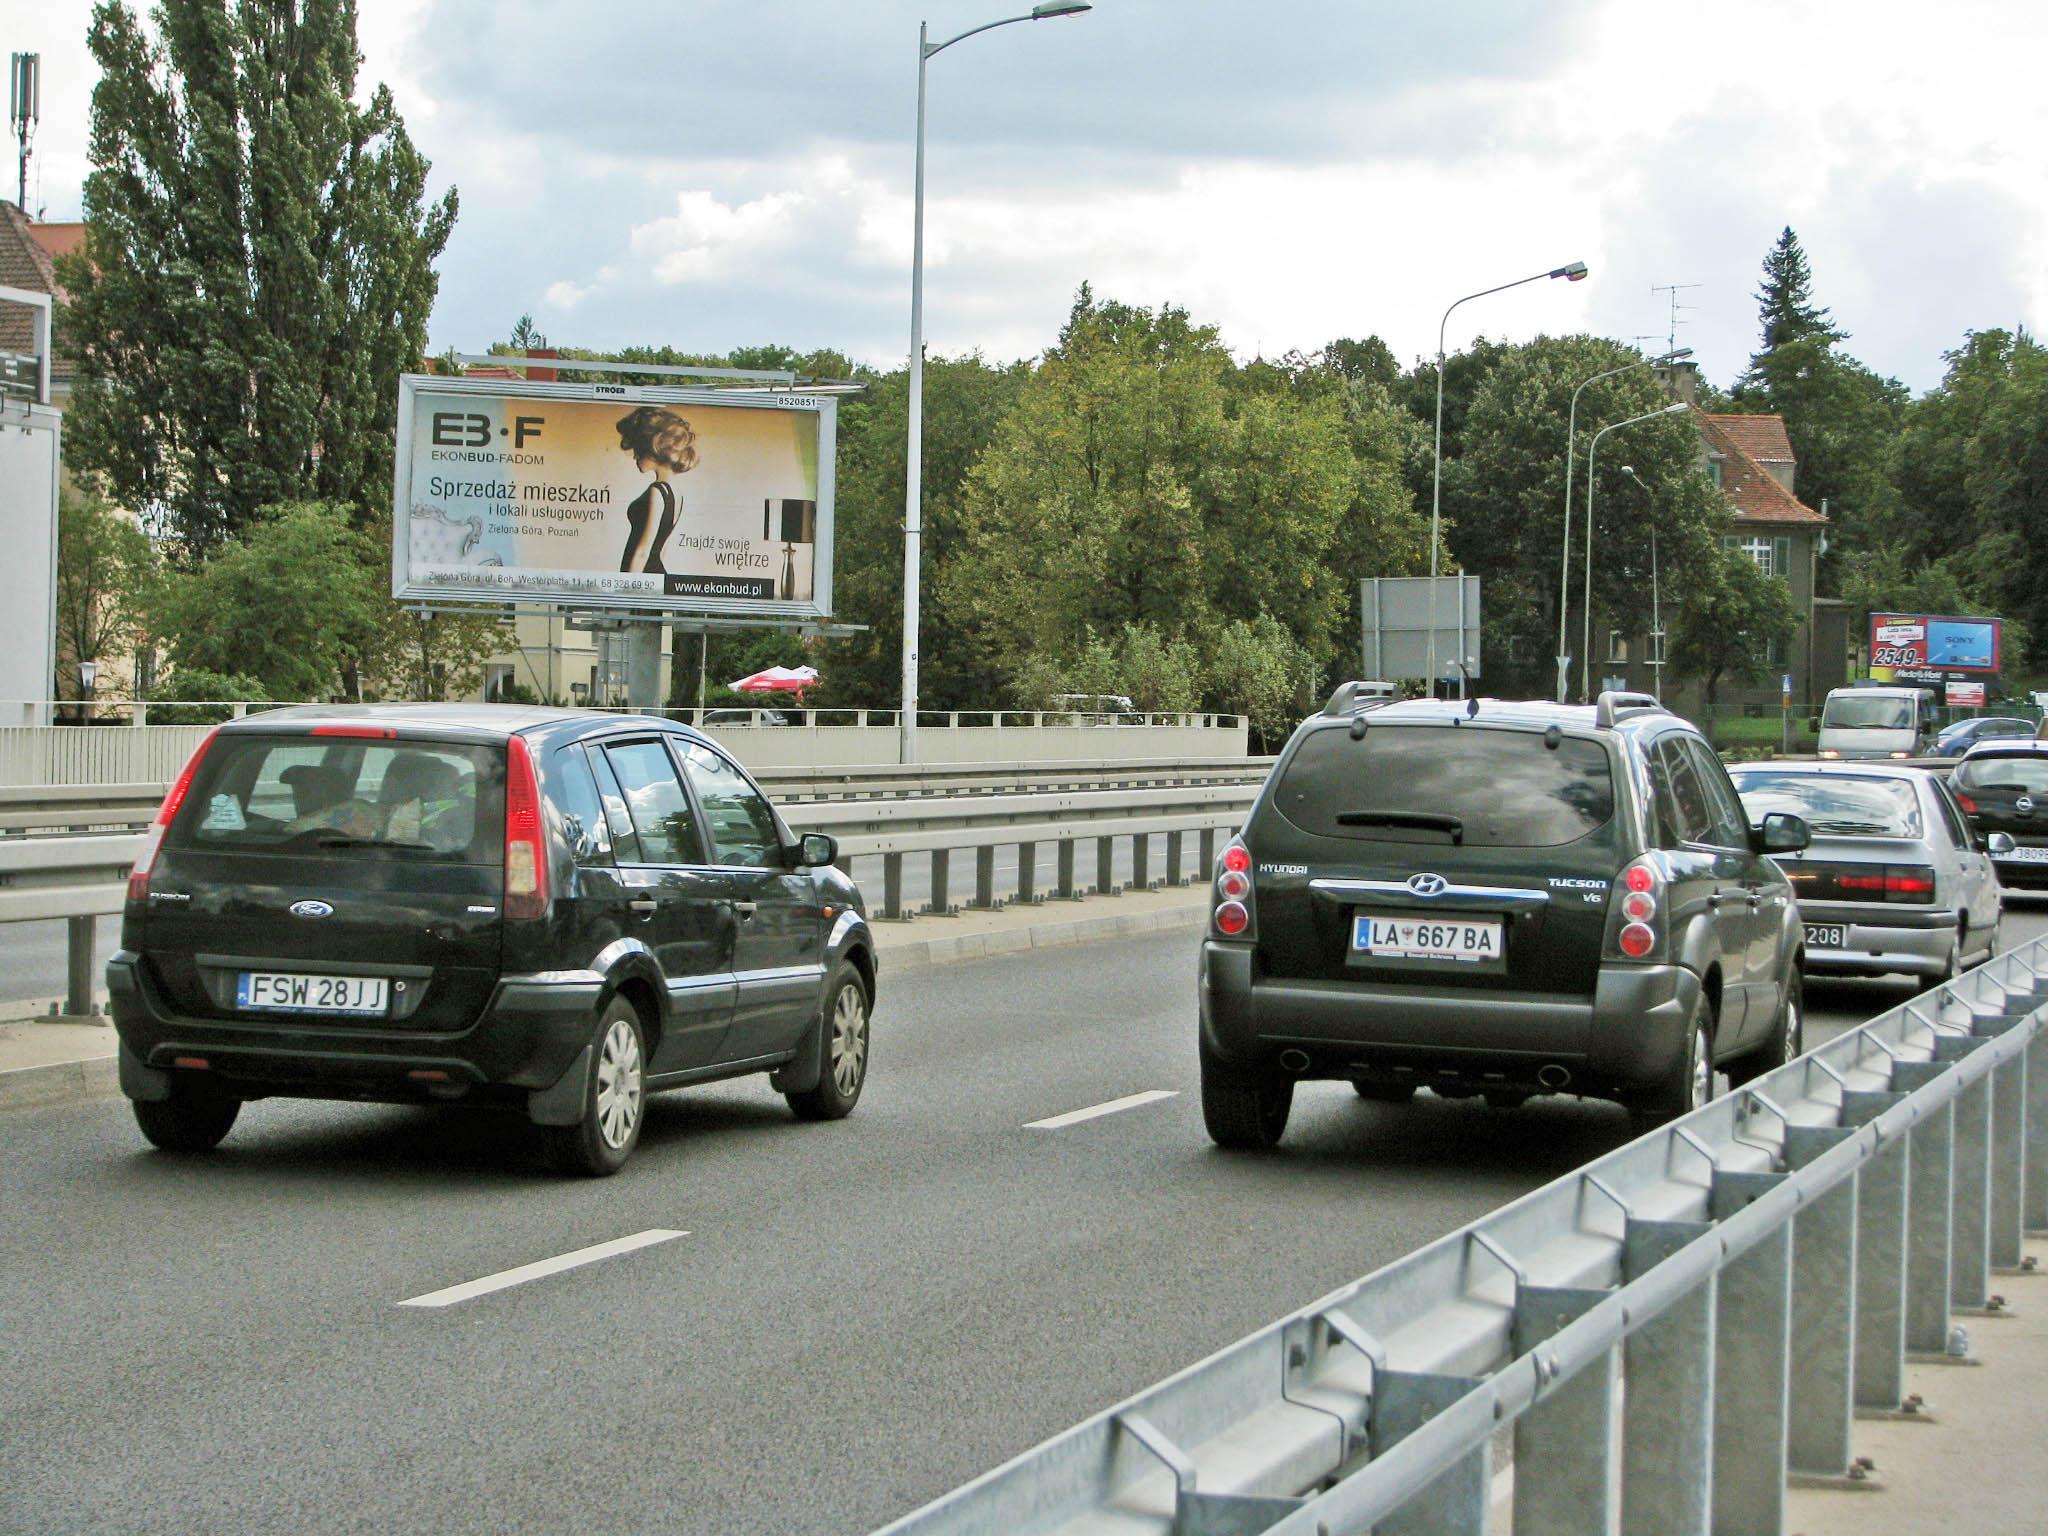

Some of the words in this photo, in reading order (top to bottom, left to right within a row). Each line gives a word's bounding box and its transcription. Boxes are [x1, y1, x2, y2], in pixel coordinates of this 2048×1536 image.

[778, 397, 816, 407] 8520851
[431, 450, 544, 465] EKONBUD-FADOM
[430, 476, 516, 501] Sprzedaż
[523, 482, 610, 504] mieszkań
[488, 503, 493, 515] i
[496, 503, 528, 517] lokali
[532, 506, 604, 522] usługowych
[488, 523, 519, 534] Zielona
[548, 526, 579, 537] Poznań
[678, 533, 715, 550] Znajdź
[718, 537, 750, 551] swoje
[715, 552, 769, 570] wnętrze
[674, 581, 762, 595] www.ekonbud.pl
[1945, 636, 1975, 644] SONY
[1260, 863, 1308, 874] HYUNDAI
[1582, 893, 1602, 903] V6
[1373, 923, 1399, 945] LA
[1417, 925, 1458, 949] 667
[1464, 927, 1491, 951] BA
[253, 976, 309, 1005] FSW
[318, 978, 381, 1008] 28JJ
